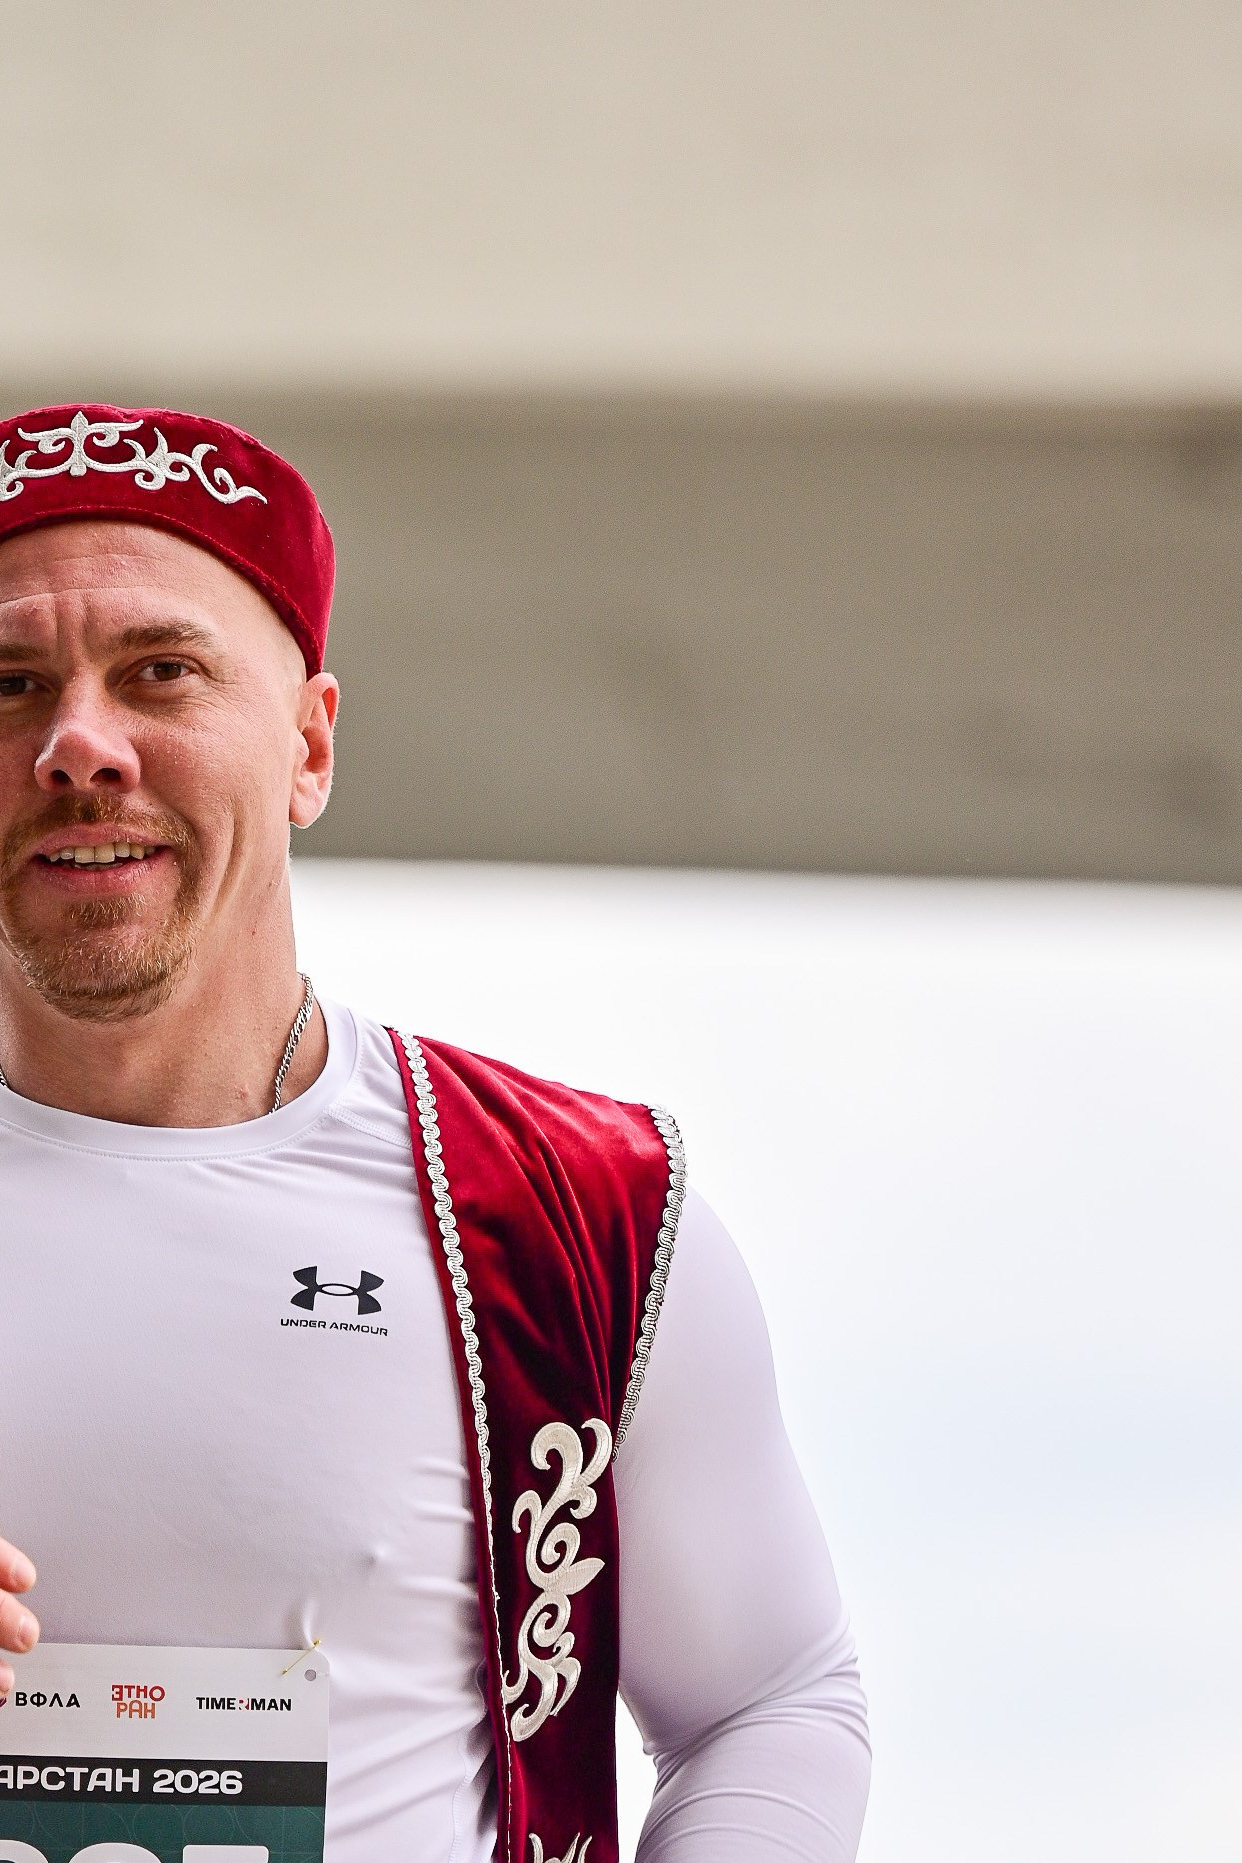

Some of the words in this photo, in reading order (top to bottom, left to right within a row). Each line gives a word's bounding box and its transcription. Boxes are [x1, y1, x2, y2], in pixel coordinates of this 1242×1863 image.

[280, 1318, 327, 1329] UNDER
[329, 1321, 389, 1337] ARMOUR
[111, 1684, 166, 1702] ЭТНО
[152, 1768, 243, 1795] 2026
